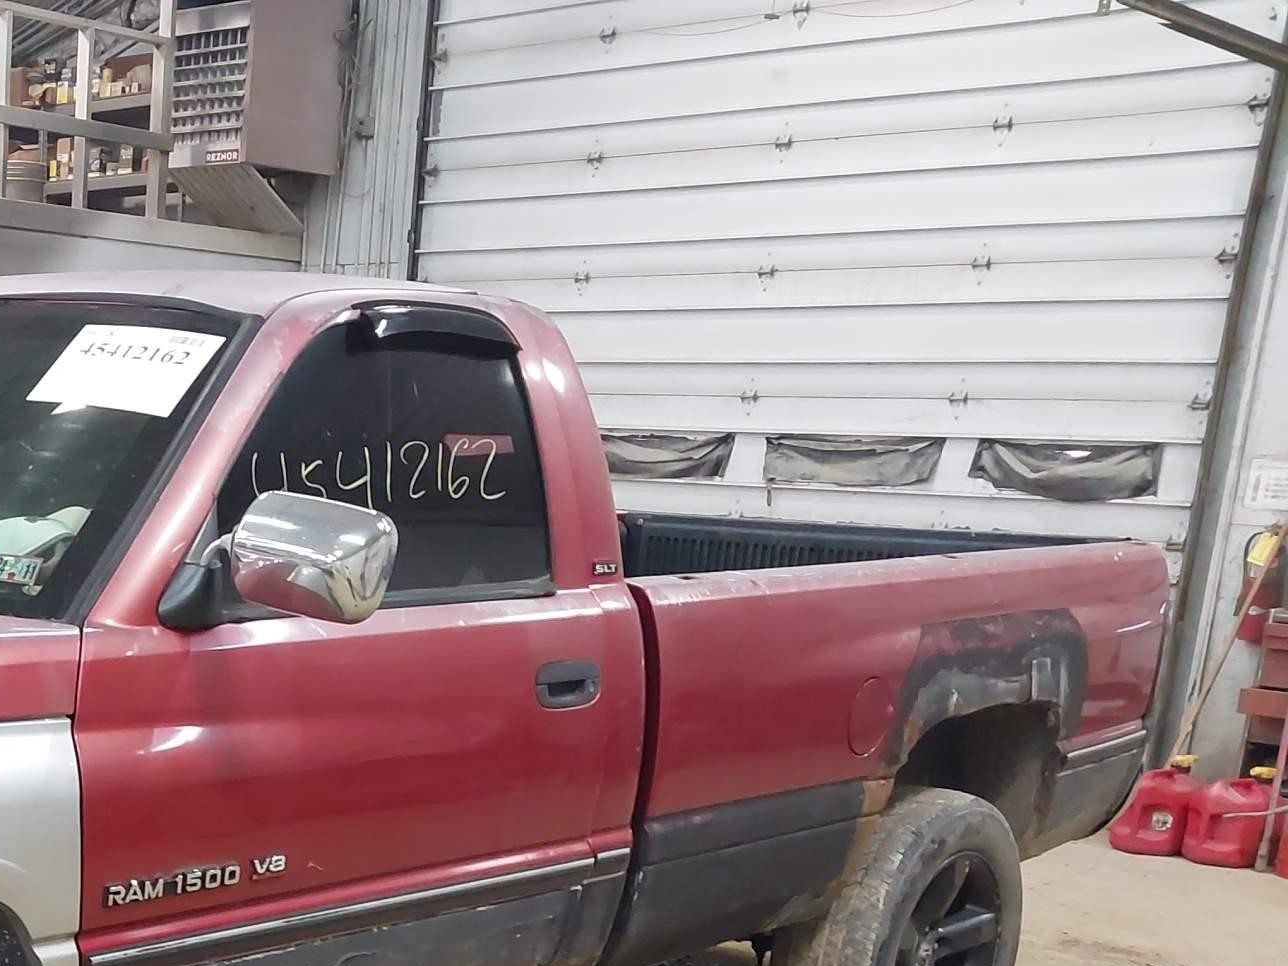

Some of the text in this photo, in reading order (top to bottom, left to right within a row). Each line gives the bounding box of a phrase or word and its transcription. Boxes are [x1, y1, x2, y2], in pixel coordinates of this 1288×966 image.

[206, 151, 238, 161] REZNOR
[79, 342, 191, 365] 45412162
[251, 437, 507, 510] 45412162
[595, 564, 617, 573] SLT
[106, 854, 287, 907] RAM 1500 V8
